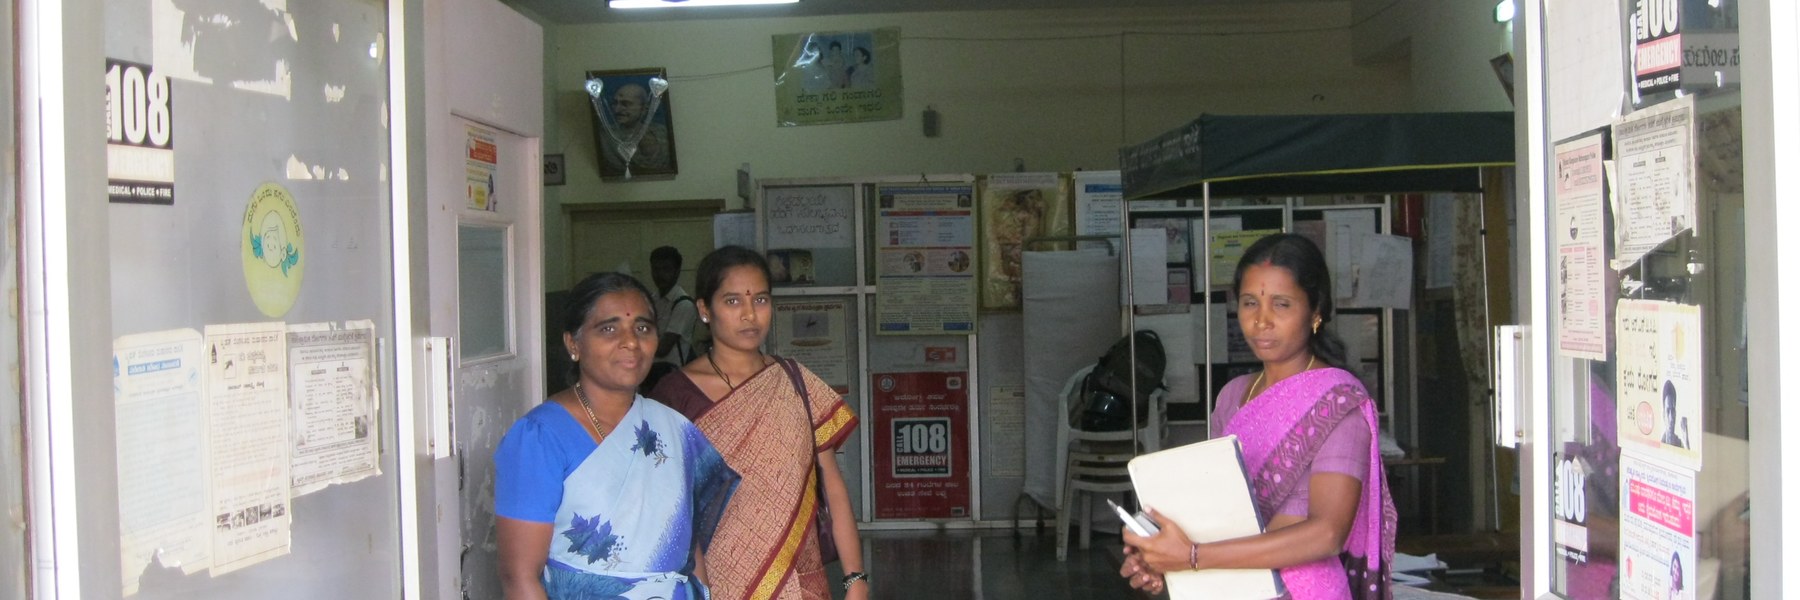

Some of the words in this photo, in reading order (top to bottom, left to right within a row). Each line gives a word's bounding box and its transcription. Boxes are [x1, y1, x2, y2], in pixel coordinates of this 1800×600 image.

[1637, 38, 1680, 71] EMERGENCY
[106, 65, 169, 145] 108
[108, 184, 132, 195] MEDICAL
[136, 186, 156, 197] POLICE
[159, 188, 172, 198] FIRE
[898, 423, 946, 454] 108
[896, 455, 947, 466] EMERGENCY
[1556, 459, 1585, 522] 108
